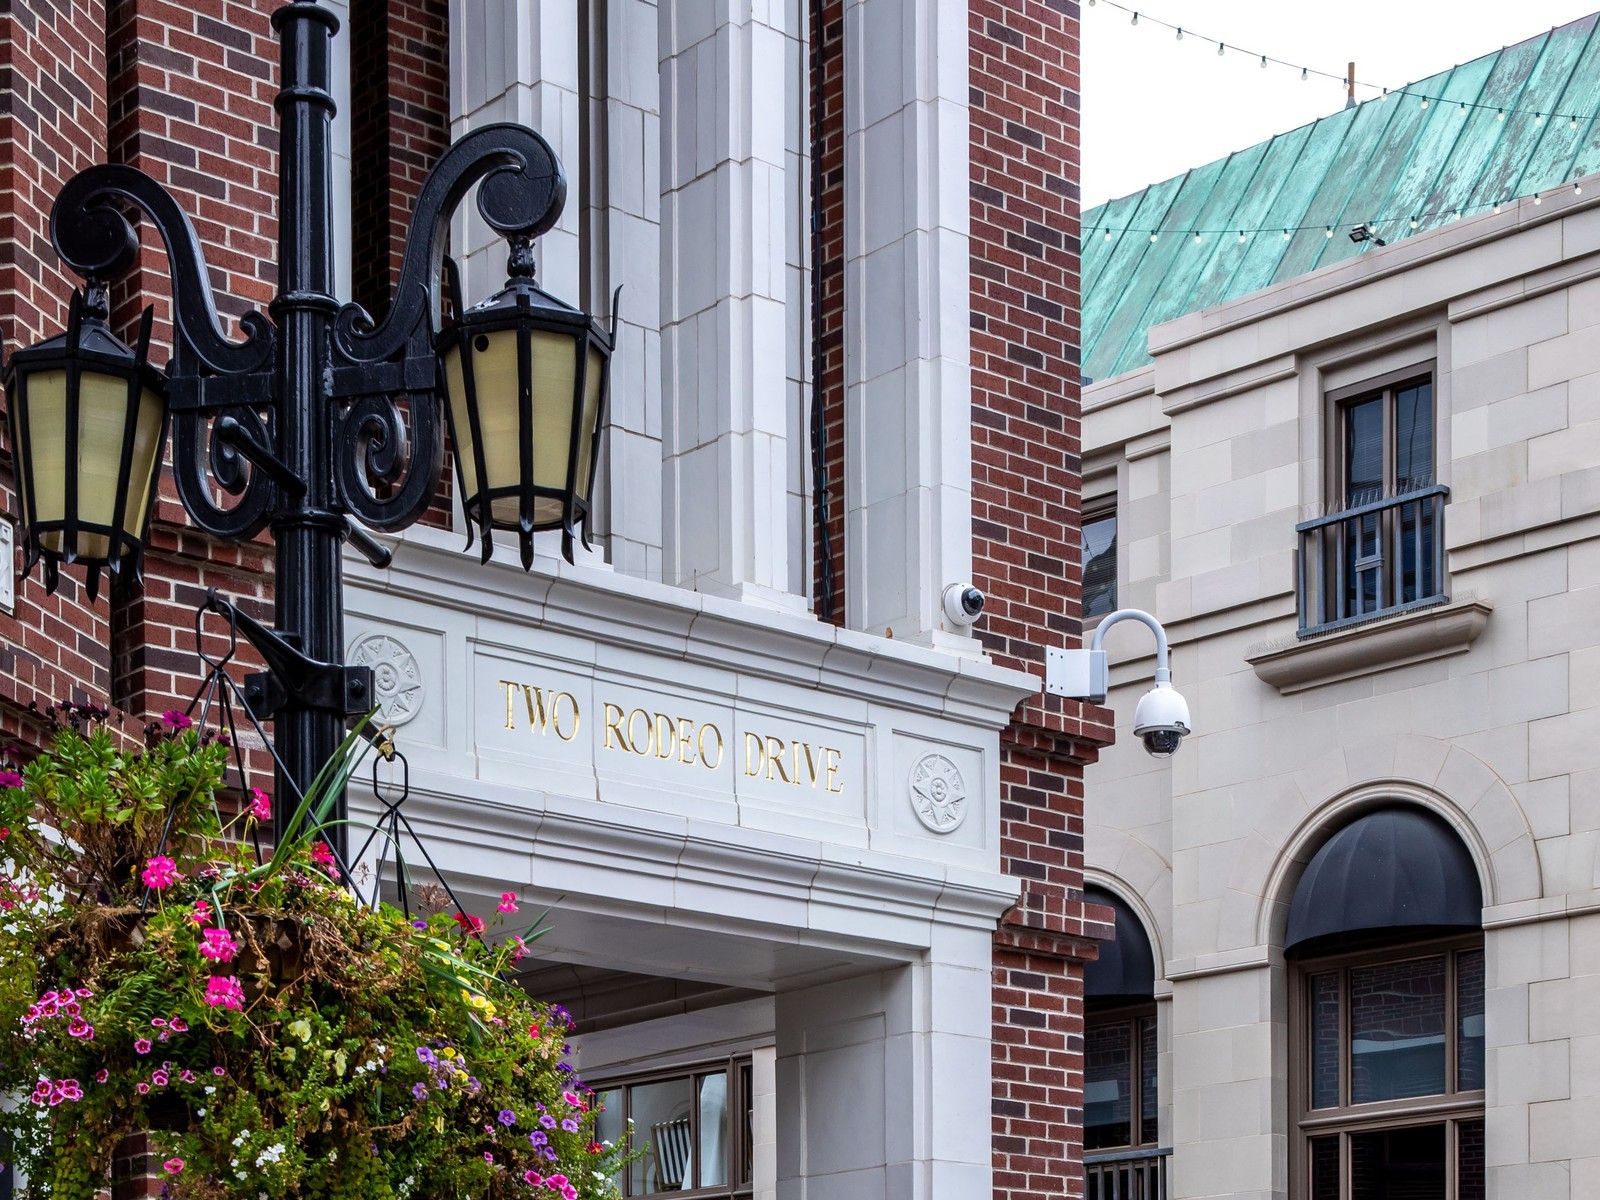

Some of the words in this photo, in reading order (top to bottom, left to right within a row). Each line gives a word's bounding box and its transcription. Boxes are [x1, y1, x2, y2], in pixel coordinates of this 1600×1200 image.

[498, 679, 580, 742] TWO
[603, 702, 724, 770] RODEO
[743, 731, 844, 795] DRIVE
